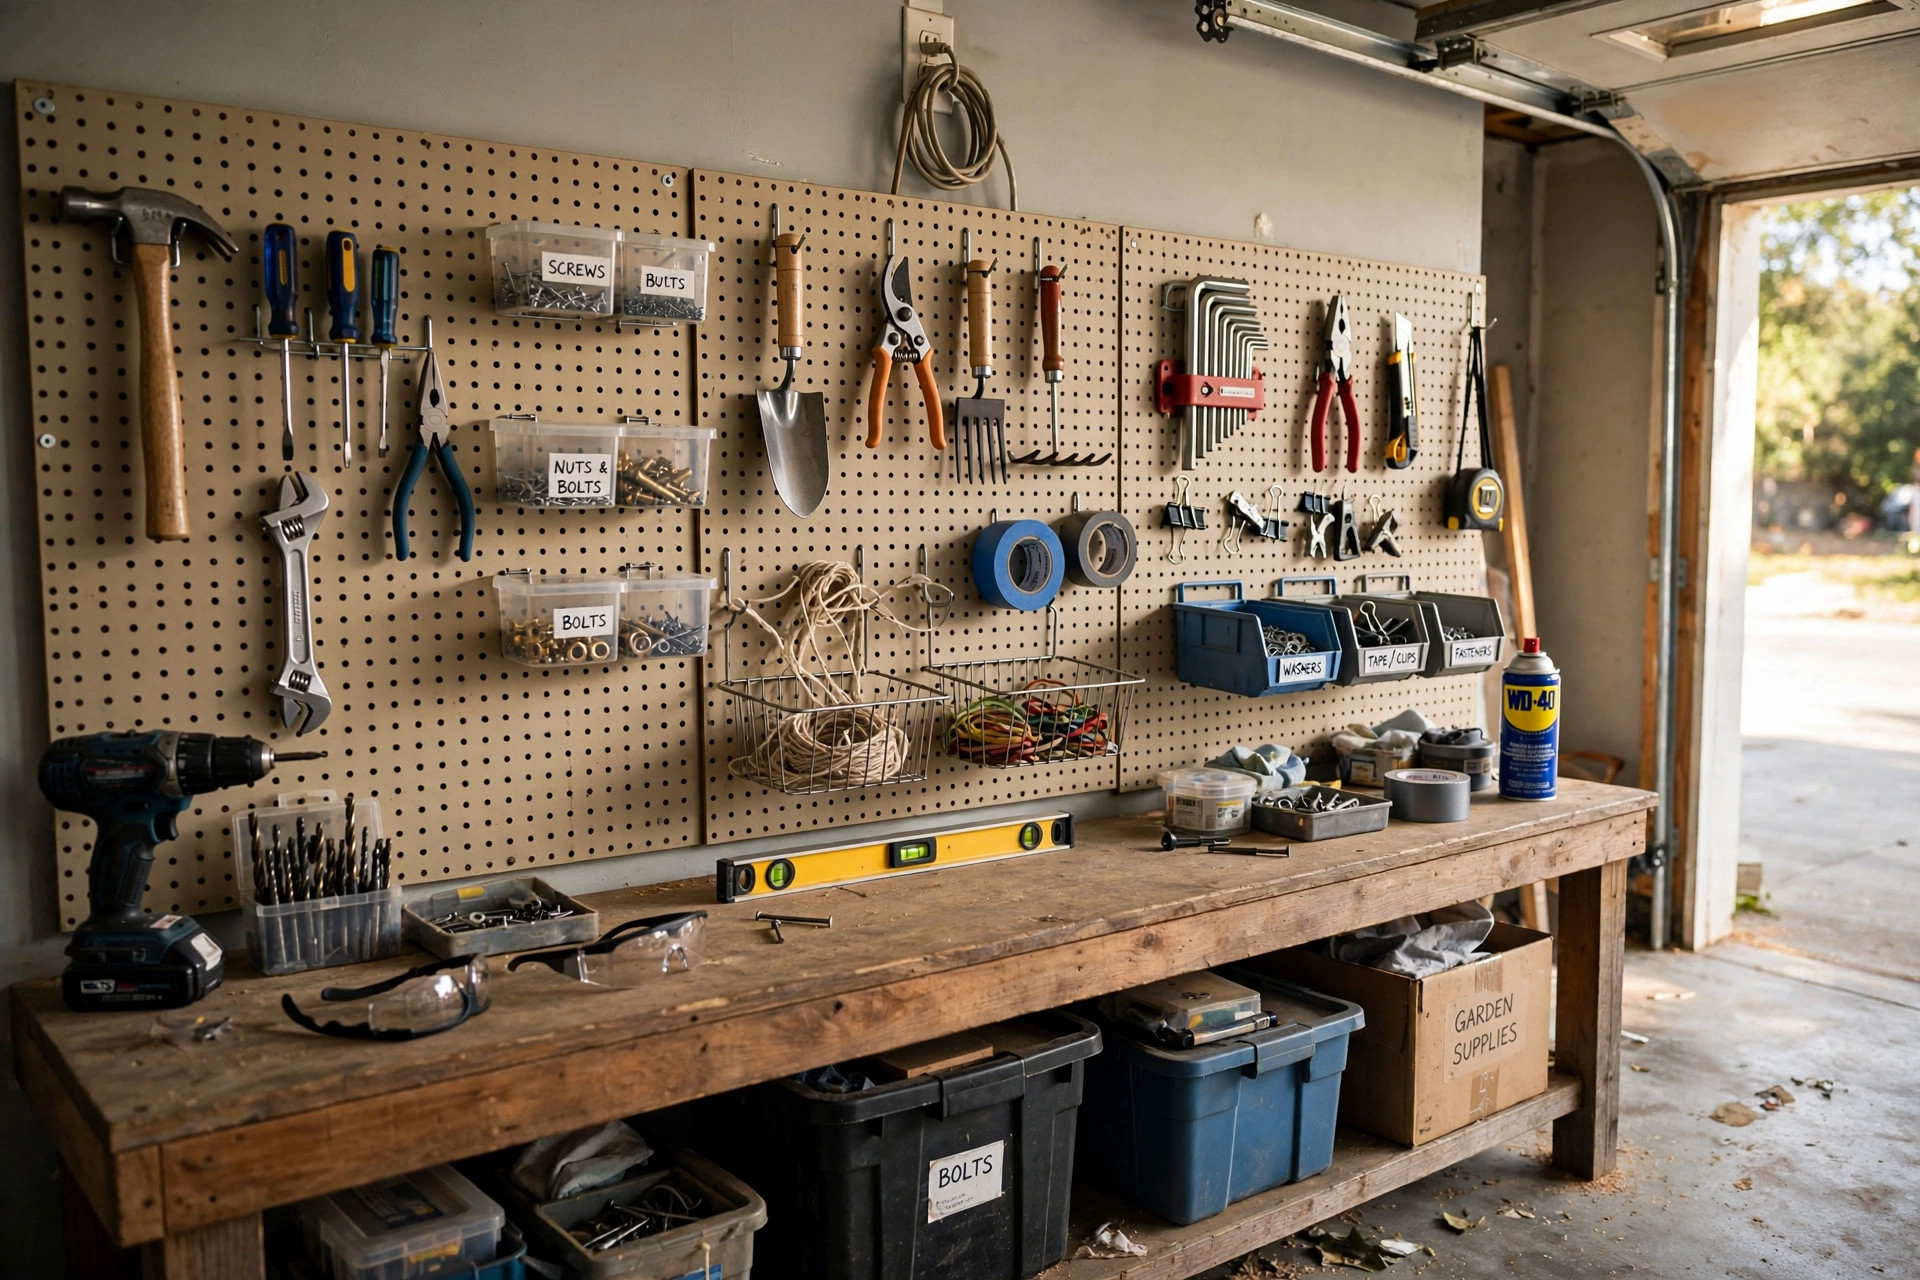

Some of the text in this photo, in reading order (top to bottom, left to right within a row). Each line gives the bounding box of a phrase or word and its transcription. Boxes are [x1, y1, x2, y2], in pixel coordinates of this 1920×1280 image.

[548, 259, 605, 279] SCREWS
[646, 273, 685, 290] BULTS
[554, 460, 608, 474] NUTS &
[557, 480, 601, 494] BOLTS
[562, 614, 607, 630] BOLTS
[1283, 661, 1322, 676] WASHERS
[1507, 688, 1555, 711] WD-40
[1455, 993, 1513, 1033] GARDEN
[1453, 1022, 1517, 1065] SUPPLIES
[939, 1154, 993, 1189] BOLTS
